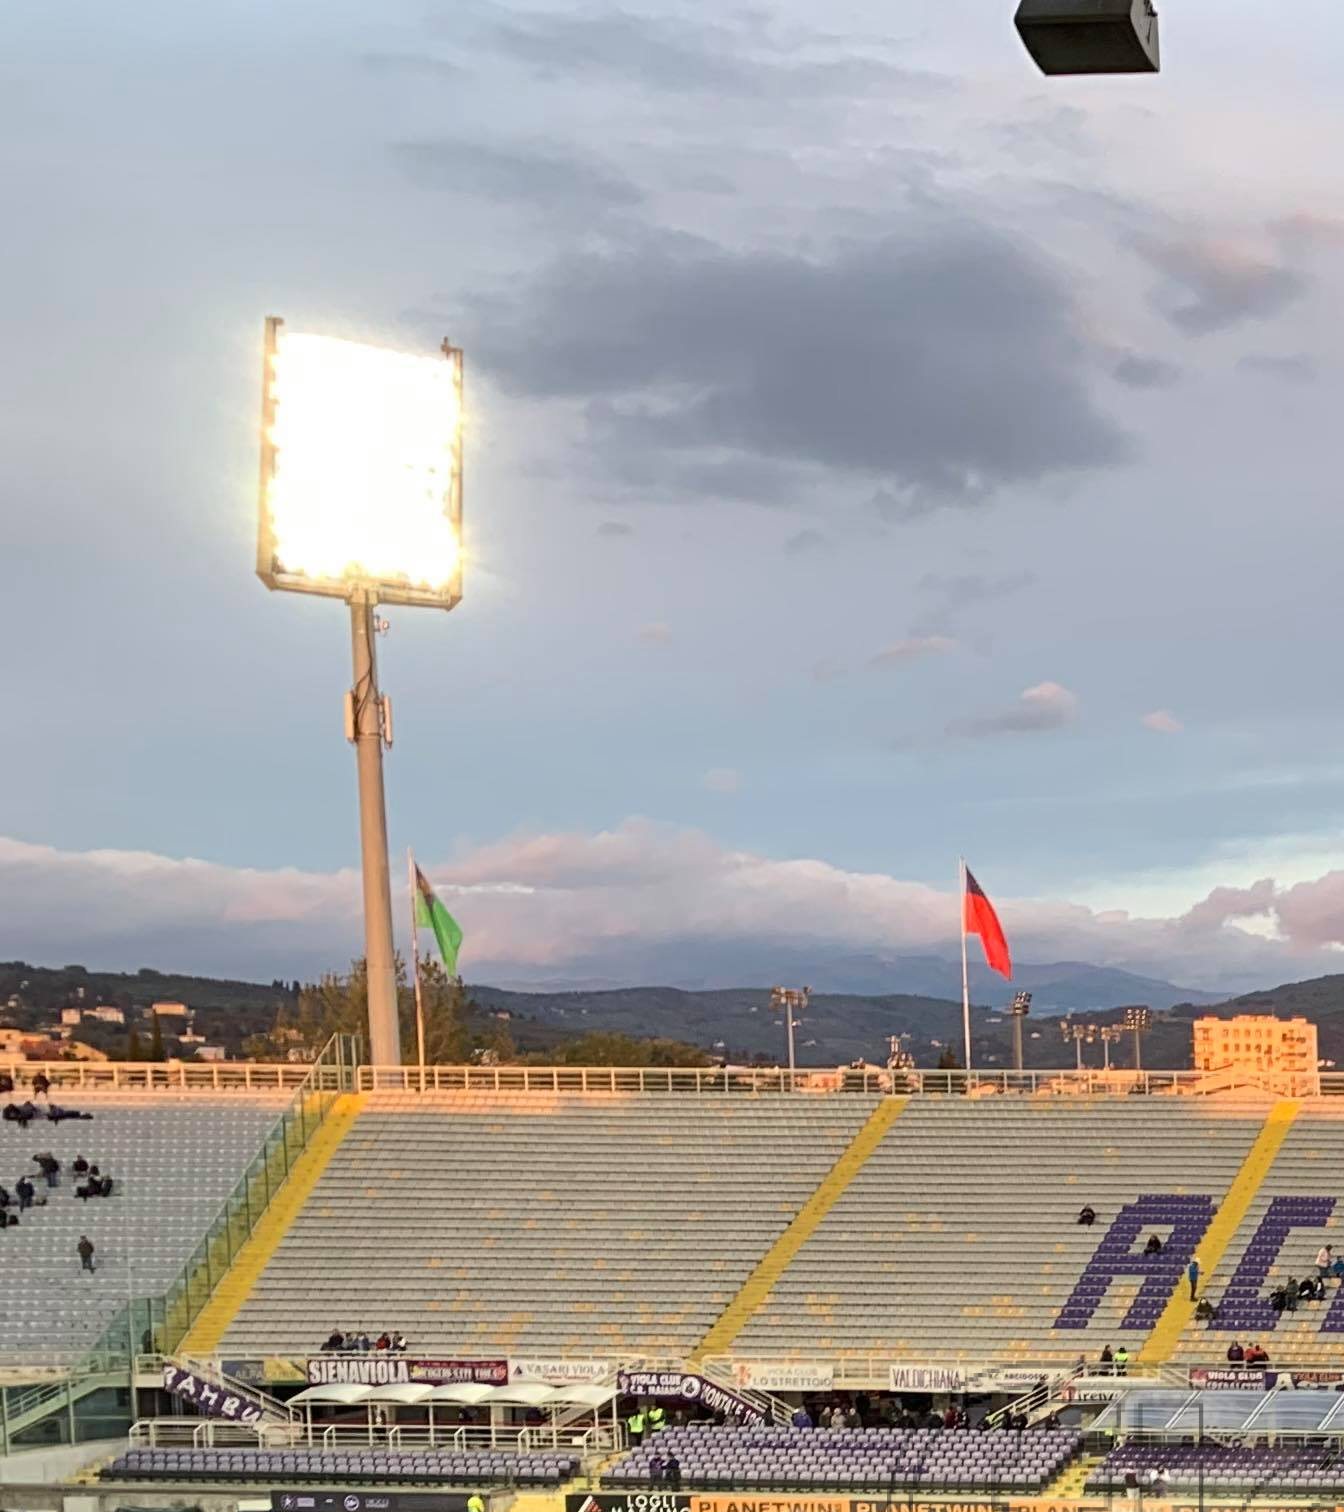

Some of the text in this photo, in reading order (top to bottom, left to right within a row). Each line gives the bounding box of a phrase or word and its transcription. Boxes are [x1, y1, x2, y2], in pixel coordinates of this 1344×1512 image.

[309, 1360, 409, 1384] SIENAVIOLA
[753, 1378, 768, 1386] LO
[627, 1495, 676, 1507] LOGLI
